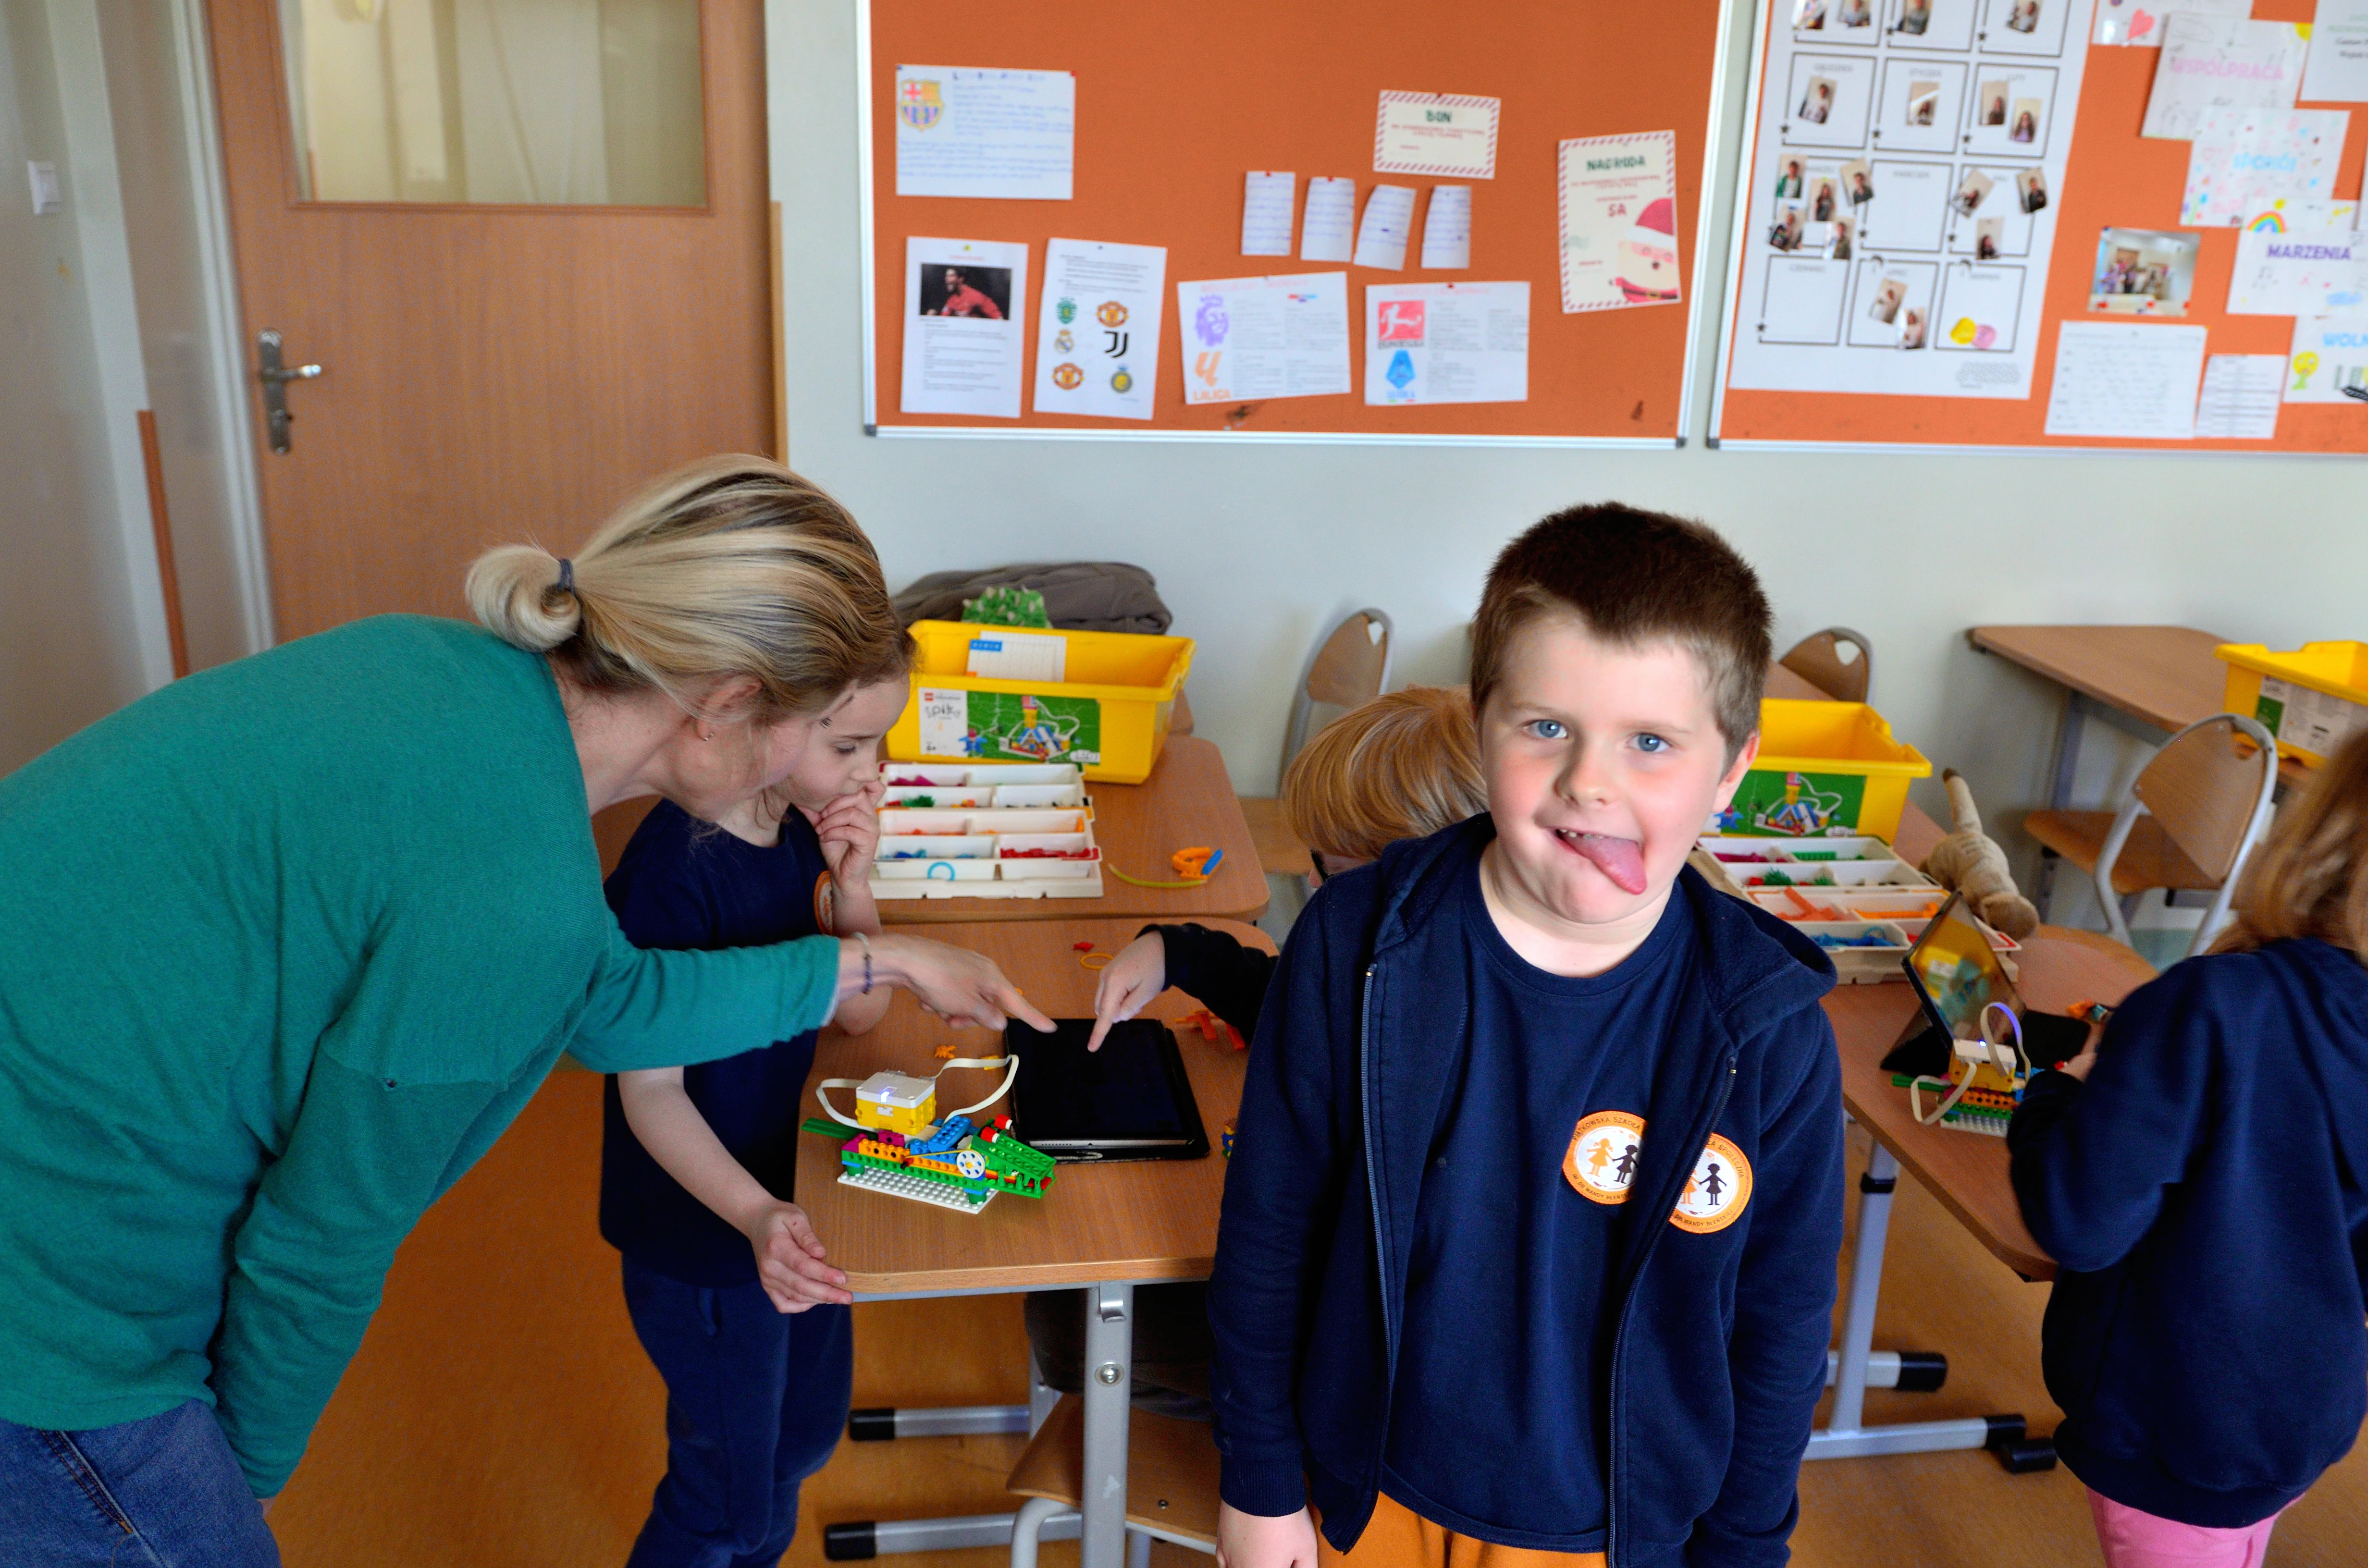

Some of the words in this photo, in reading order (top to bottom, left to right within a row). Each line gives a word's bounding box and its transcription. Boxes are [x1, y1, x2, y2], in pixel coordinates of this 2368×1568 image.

[2267, 244, 2352, 260] MARZENIA
[1614, 1116, 1640, 1130] SZKOŁA
[1586, 1188, 1604, 1198] WANDY
[1606, 1192, 1628, 1200] BŁEŃSK
[1684, 1218, 1704, 1226] WANDY
